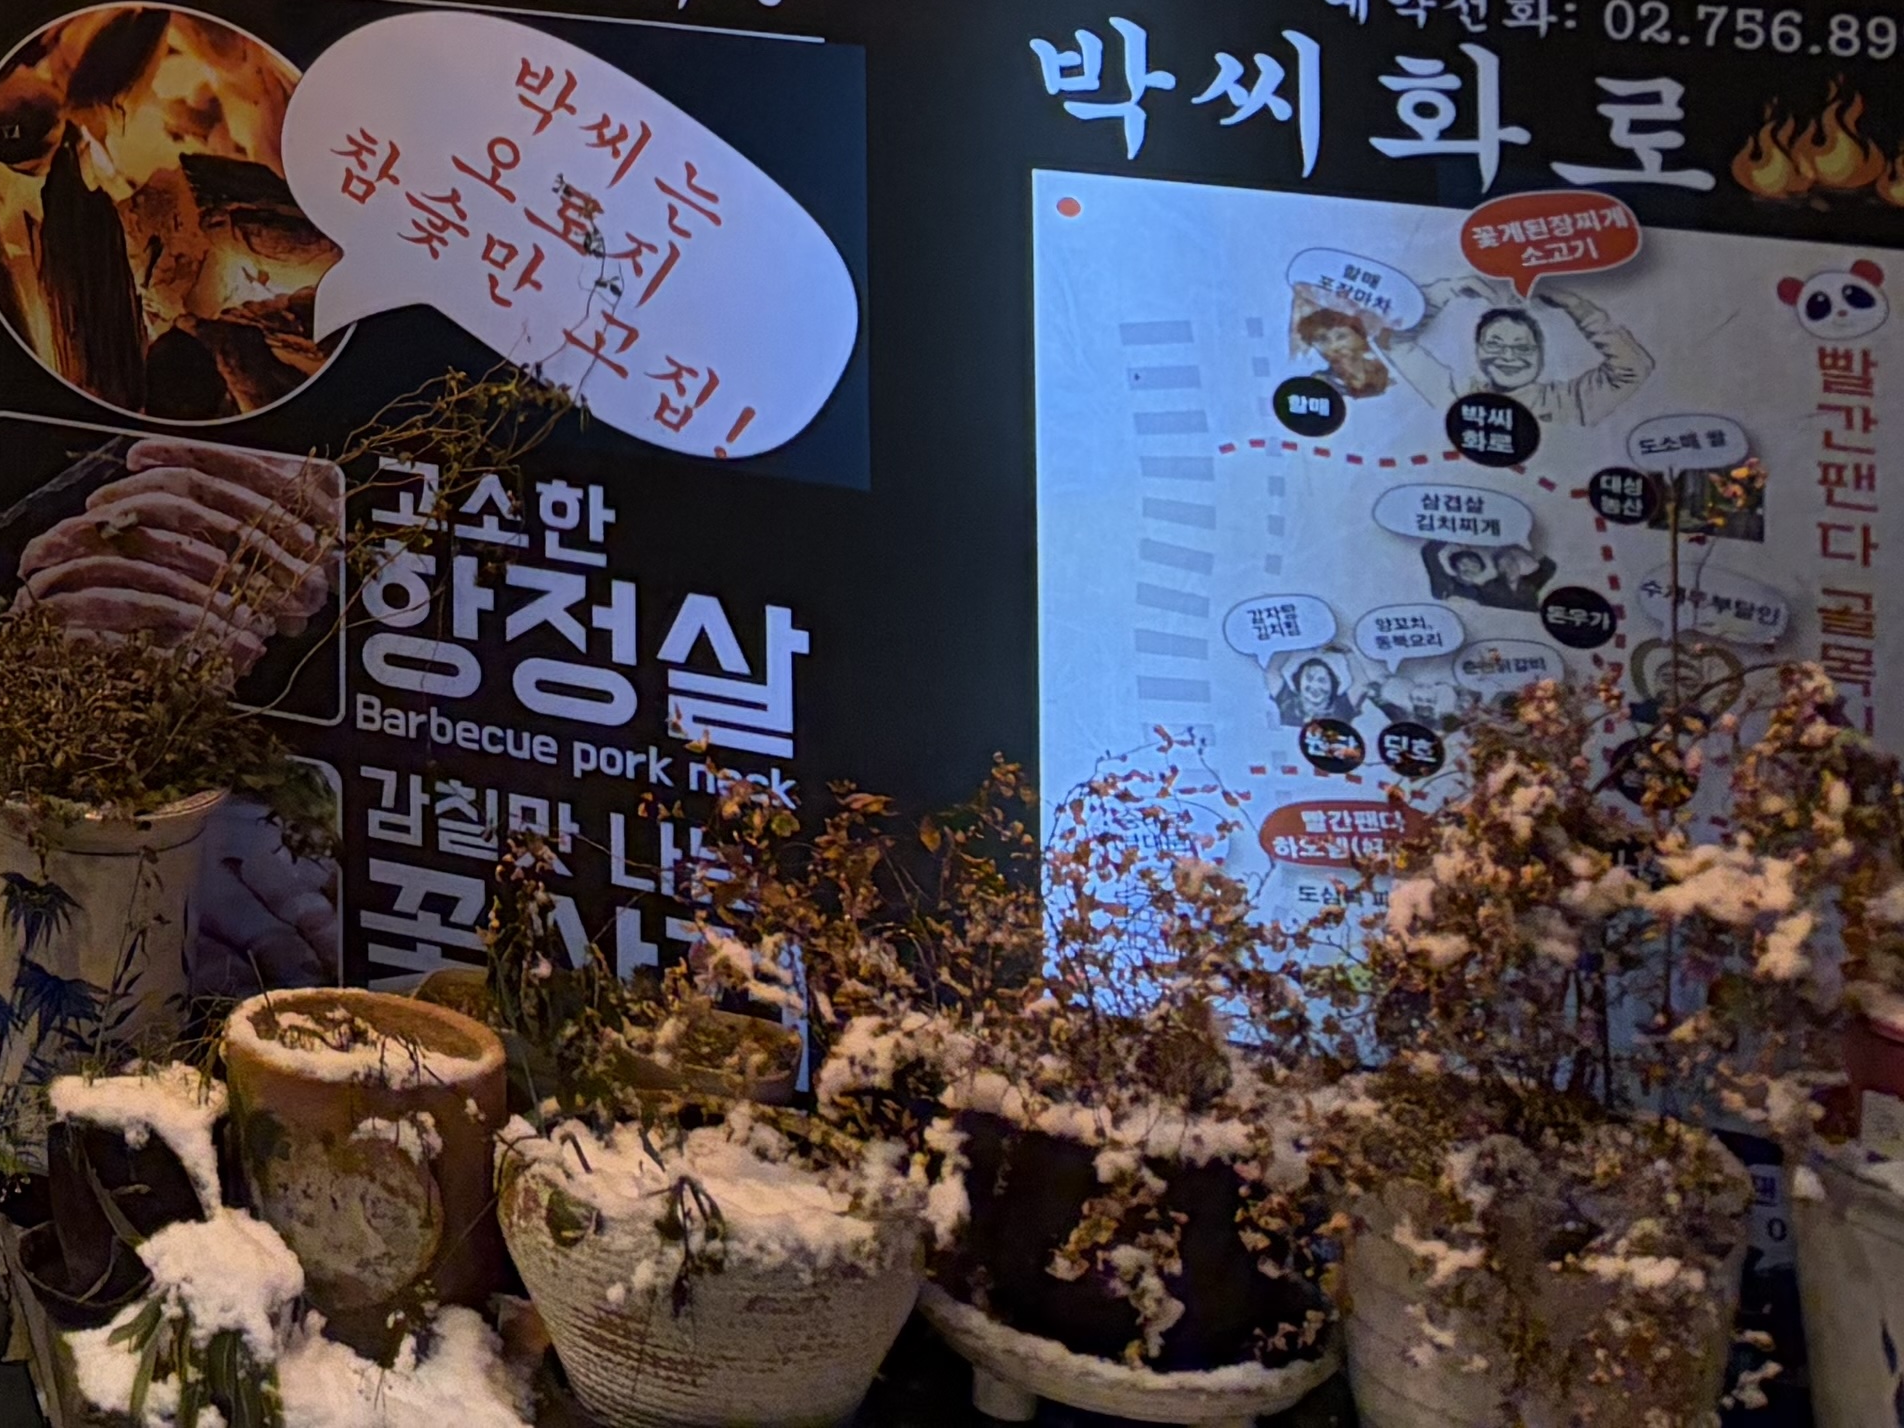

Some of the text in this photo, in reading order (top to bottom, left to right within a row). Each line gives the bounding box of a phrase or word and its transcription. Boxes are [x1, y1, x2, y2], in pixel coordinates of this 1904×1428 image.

[515, 55, 724, 241] 박씨는
[1028, 15, 1717, 194] 박씨화로
[329, 126, 757, 460] 참숯만 고집!
[1520, 237, 1599, 267] 소고기
[1461, 404, 1514, 430] 박씨
[1461, 429, 1515, 455] 화로
[371, 453, 617, 570] 고소한
[1420, 492, 1485, 516] 삼겹살
[359, 536, 810, 760] 항정살
[355, 691, 559, 766] Barbecue
[572, 736, 675, 794] pork
